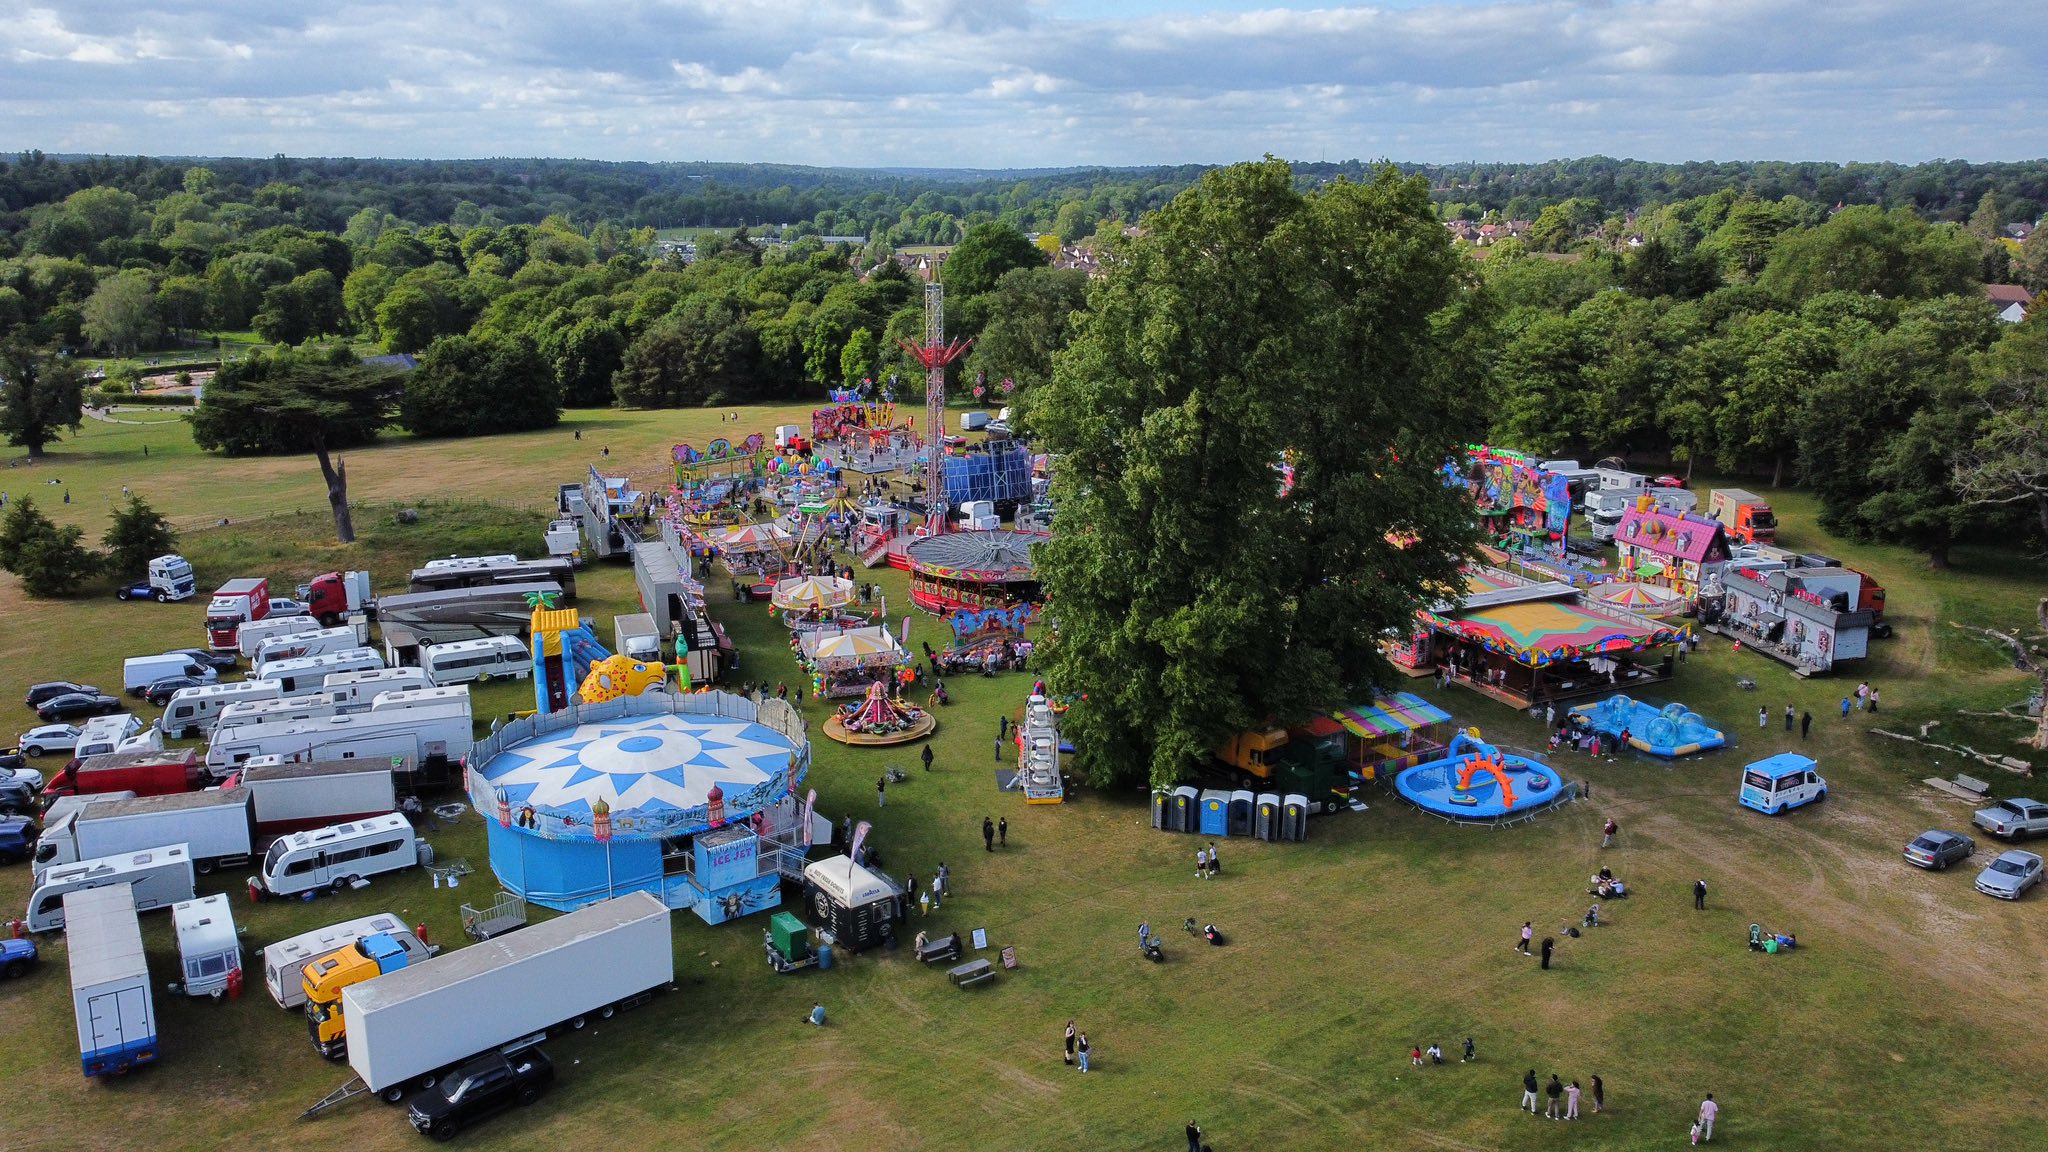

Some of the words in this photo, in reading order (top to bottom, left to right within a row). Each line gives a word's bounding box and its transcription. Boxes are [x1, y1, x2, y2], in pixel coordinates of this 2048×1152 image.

[713, 853, 730, 866] ICE
[734, 848, 752, 860] JET
[830, 880, 846, 895] DONUTS
